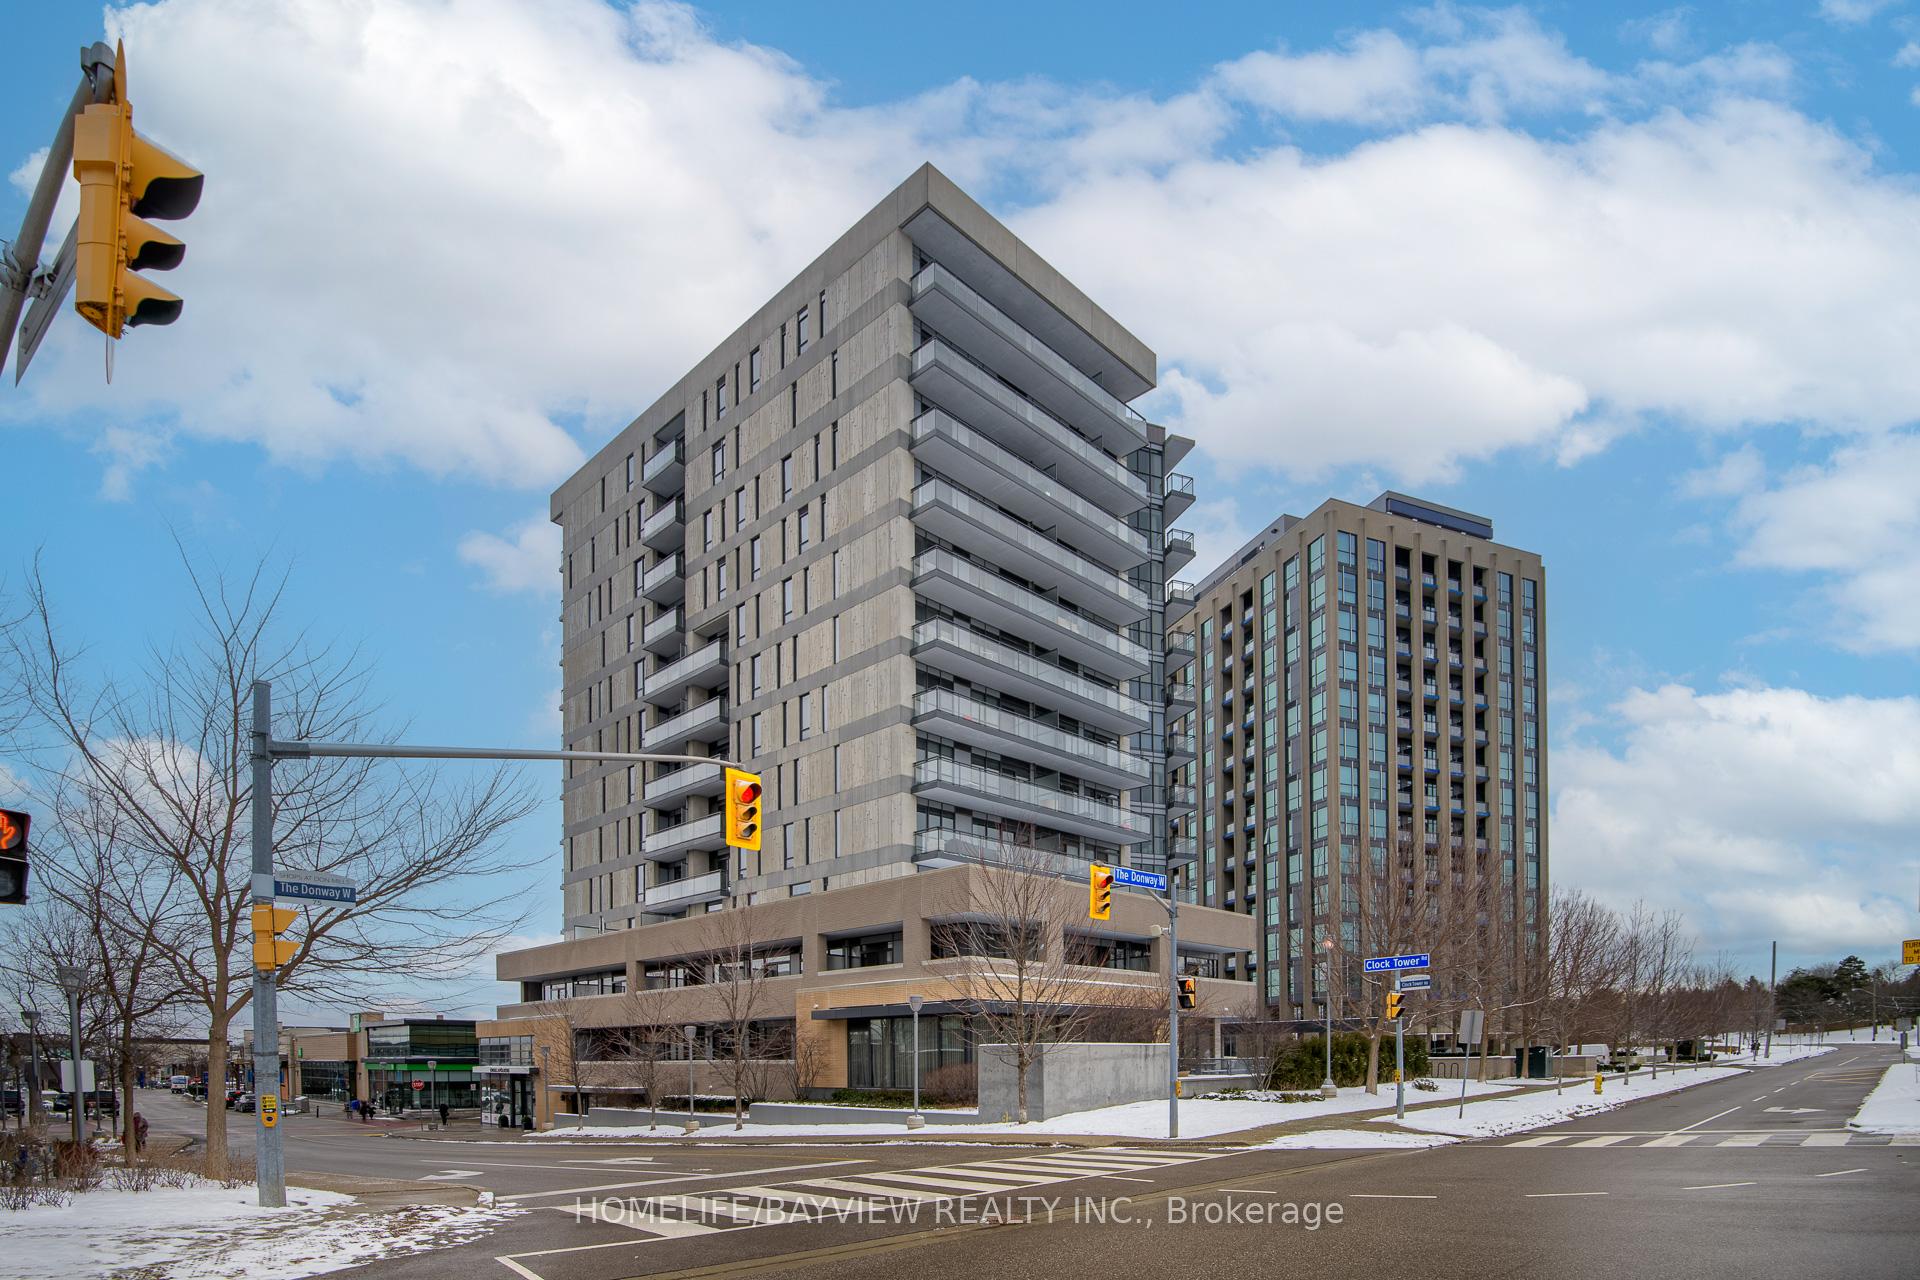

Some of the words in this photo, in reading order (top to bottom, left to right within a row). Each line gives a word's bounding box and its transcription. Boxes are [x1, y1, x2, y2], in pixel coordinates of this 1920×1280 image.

[1115, 869, 1129, 881] The
[1131, 871, 1159, 888] Donway
[1159, 876, 1165, 886] W
[280, 882, 299, 893] The
[301, 884, 341, 900] Donway
[342, 888, 351, 898] W
[1366, 960, 1390, 969] Clock
[1393, 958, 1420, 967] Tower
